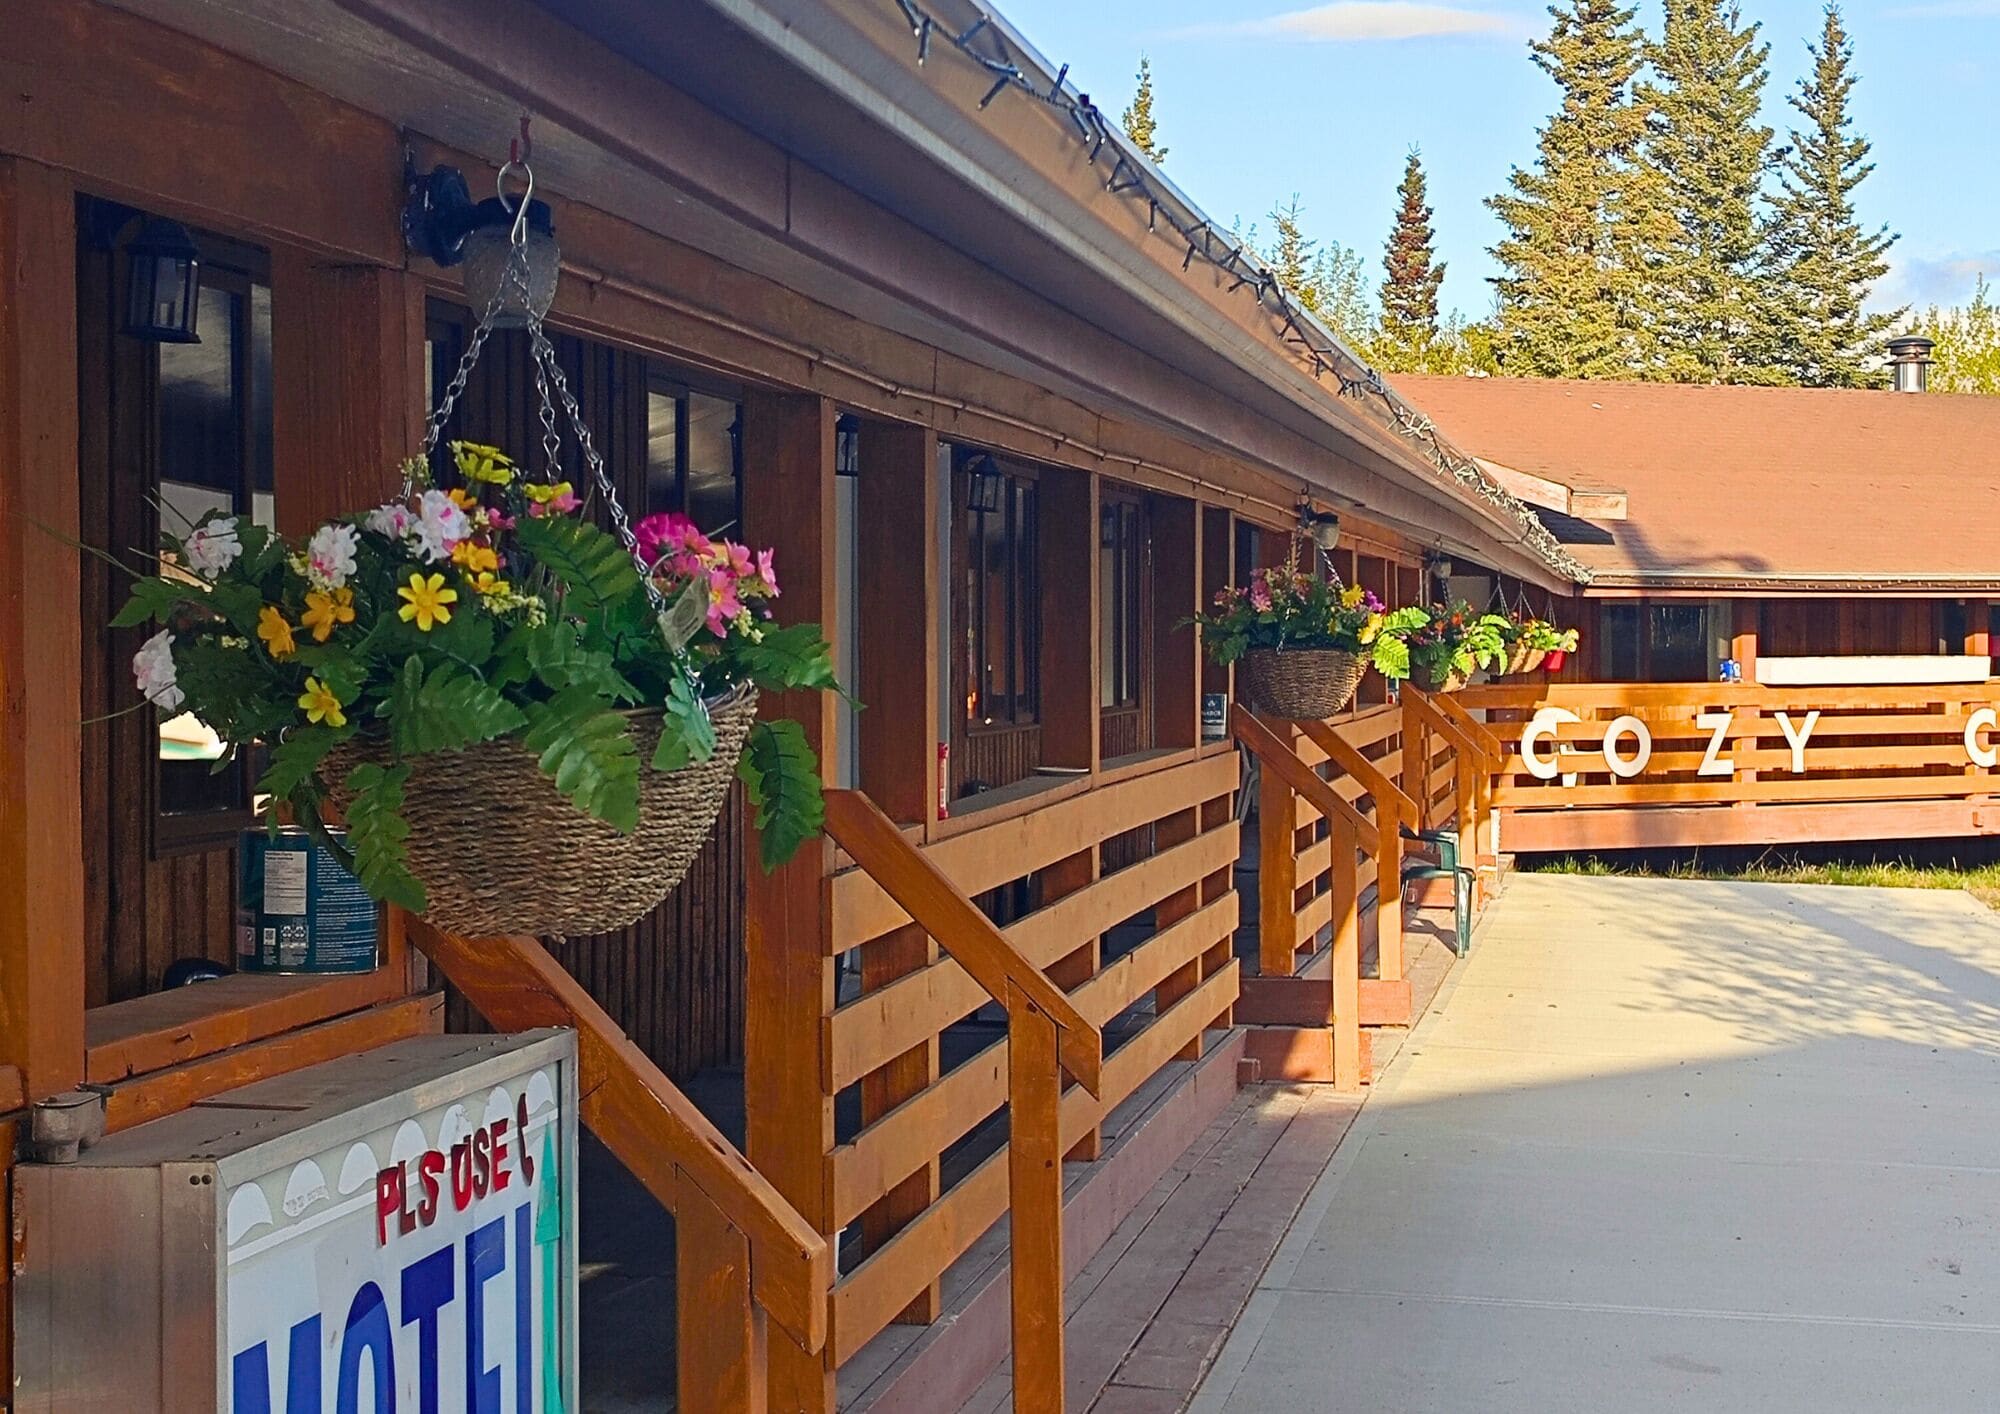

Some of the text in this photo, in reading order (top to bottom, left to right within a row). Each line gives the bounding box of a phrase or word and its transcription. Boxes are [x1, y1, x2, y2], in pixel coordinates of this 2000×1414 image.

[1520, 711, 1820, 779] COZY
[377, 1150, 446, 1246] PLS
[451, 1118, 512, 1212] USE
[233, 1201, 531, 1414] TEL
